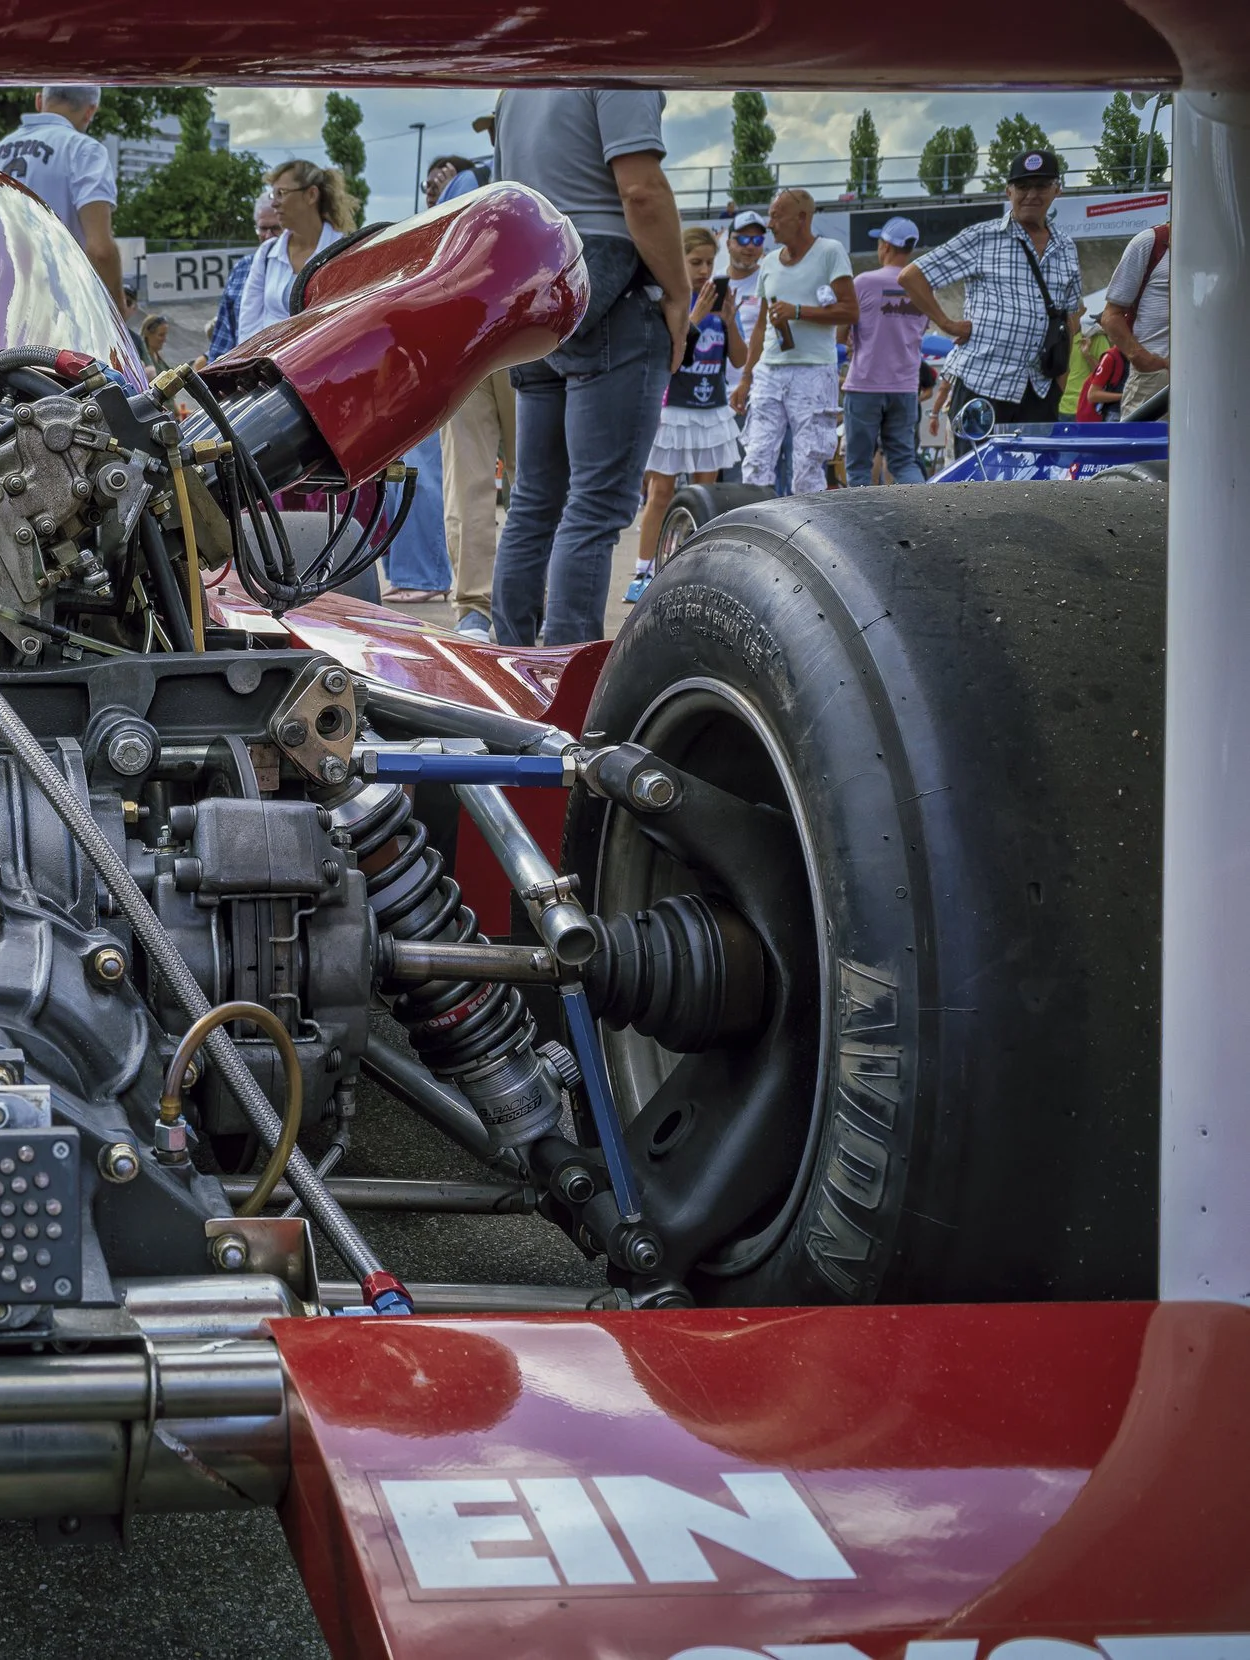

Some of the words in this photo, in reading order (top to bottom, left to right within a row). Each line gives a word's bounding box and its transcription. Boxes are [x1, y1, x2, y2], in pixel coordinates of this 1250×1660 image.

[674, 584, 707, 603] RACING
[708, 587, 755, 629] PURPOSES
[685, 603, 702, 619] FOR
[705, 606, 742, 640] HIGHWAY
[744, 633, 762, 663] USE
[428, 1013, 458, 1028] ONI
[493, 1086, 540, 1118] RACING
[805, 960, 899, 1298] AVON
[379, 1471, 858, 1590] EIN
